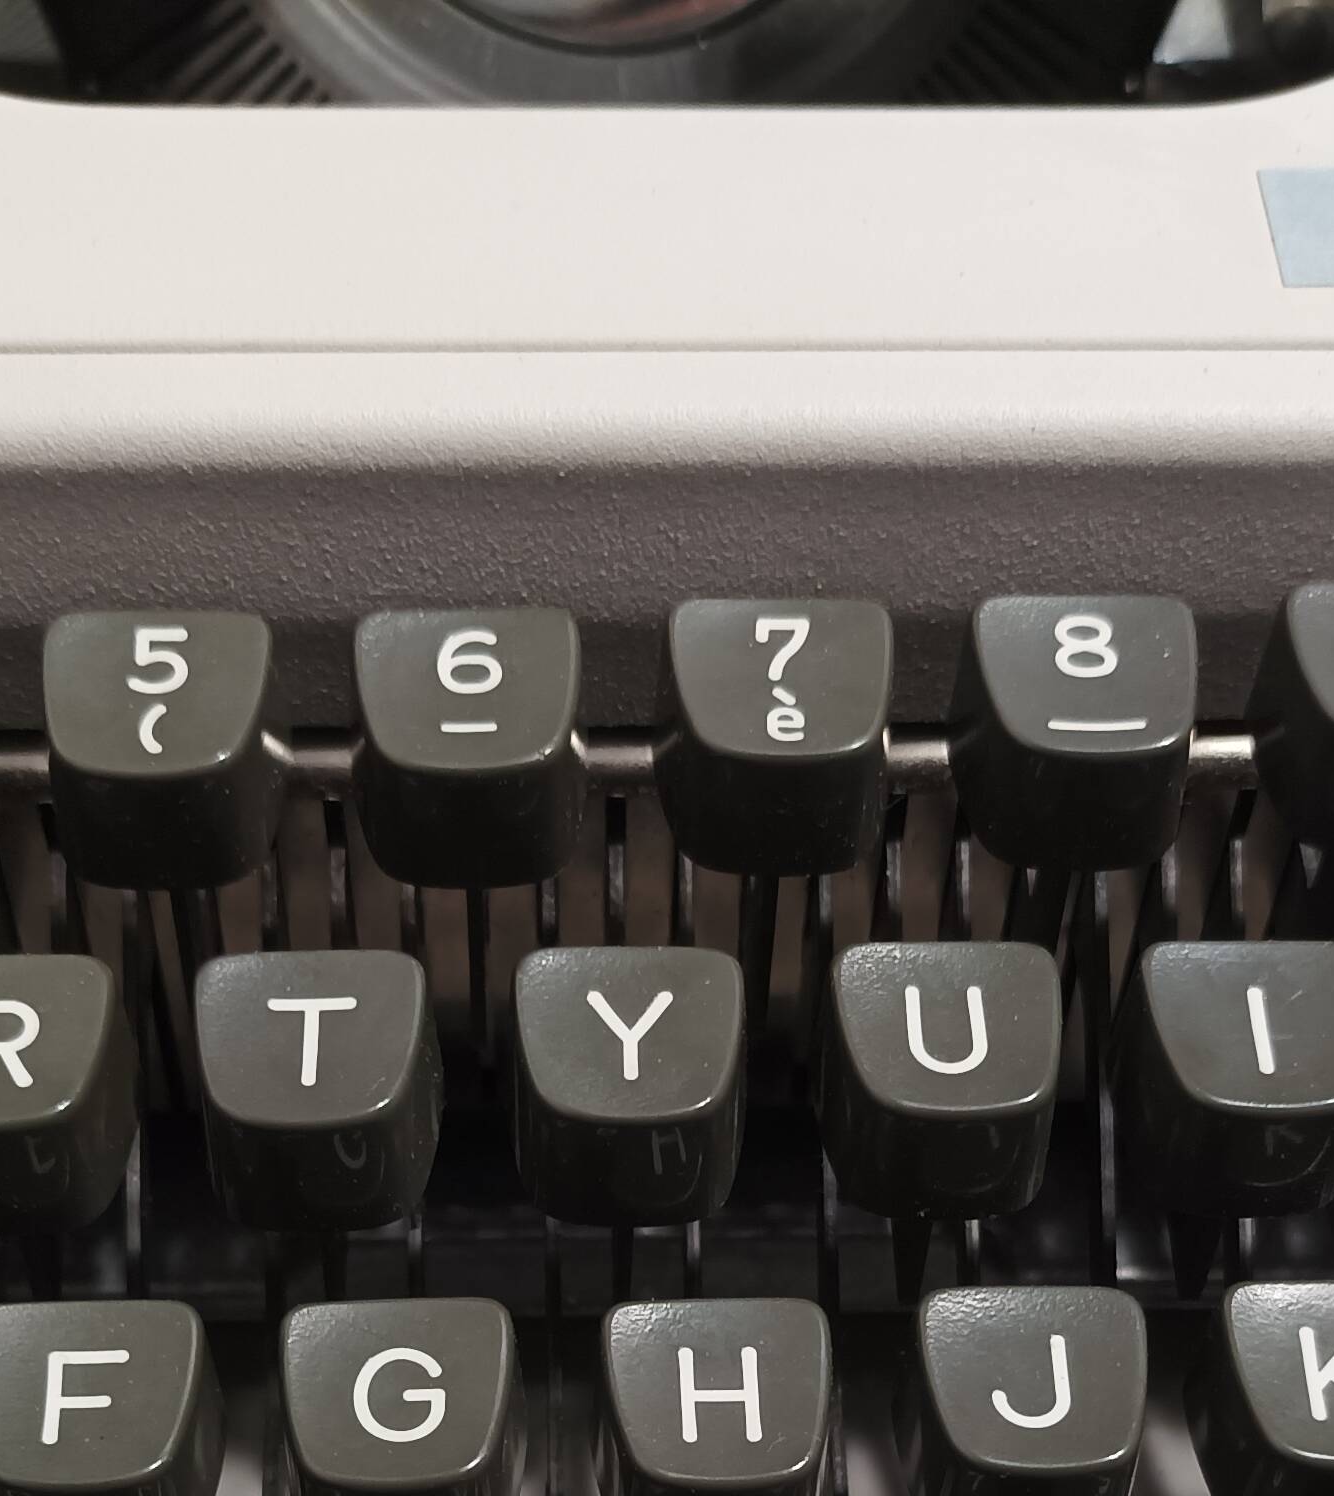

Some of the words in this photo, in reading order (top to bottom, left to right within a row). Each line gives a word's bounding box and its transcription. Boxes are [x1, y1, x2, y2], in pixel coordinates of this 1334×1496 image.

[127, 627, 189, 695] 5
[436, 629, 503, 694] 6
[755, 617, 810, 682] 7
[1054, 613, 1118, 678] 8
[267, 996, 358, 1087] T
[586, 990, 674, 1081] Y
[904, 984, 988, 1075] U
[1246, 985, 1276, 1075] I
[41, 1349, 130, 1445] F
[353, 1347, 446, 1443] G
[677, 1346, 763, 1443] H
[991, 1334, 1072, 1429] J
